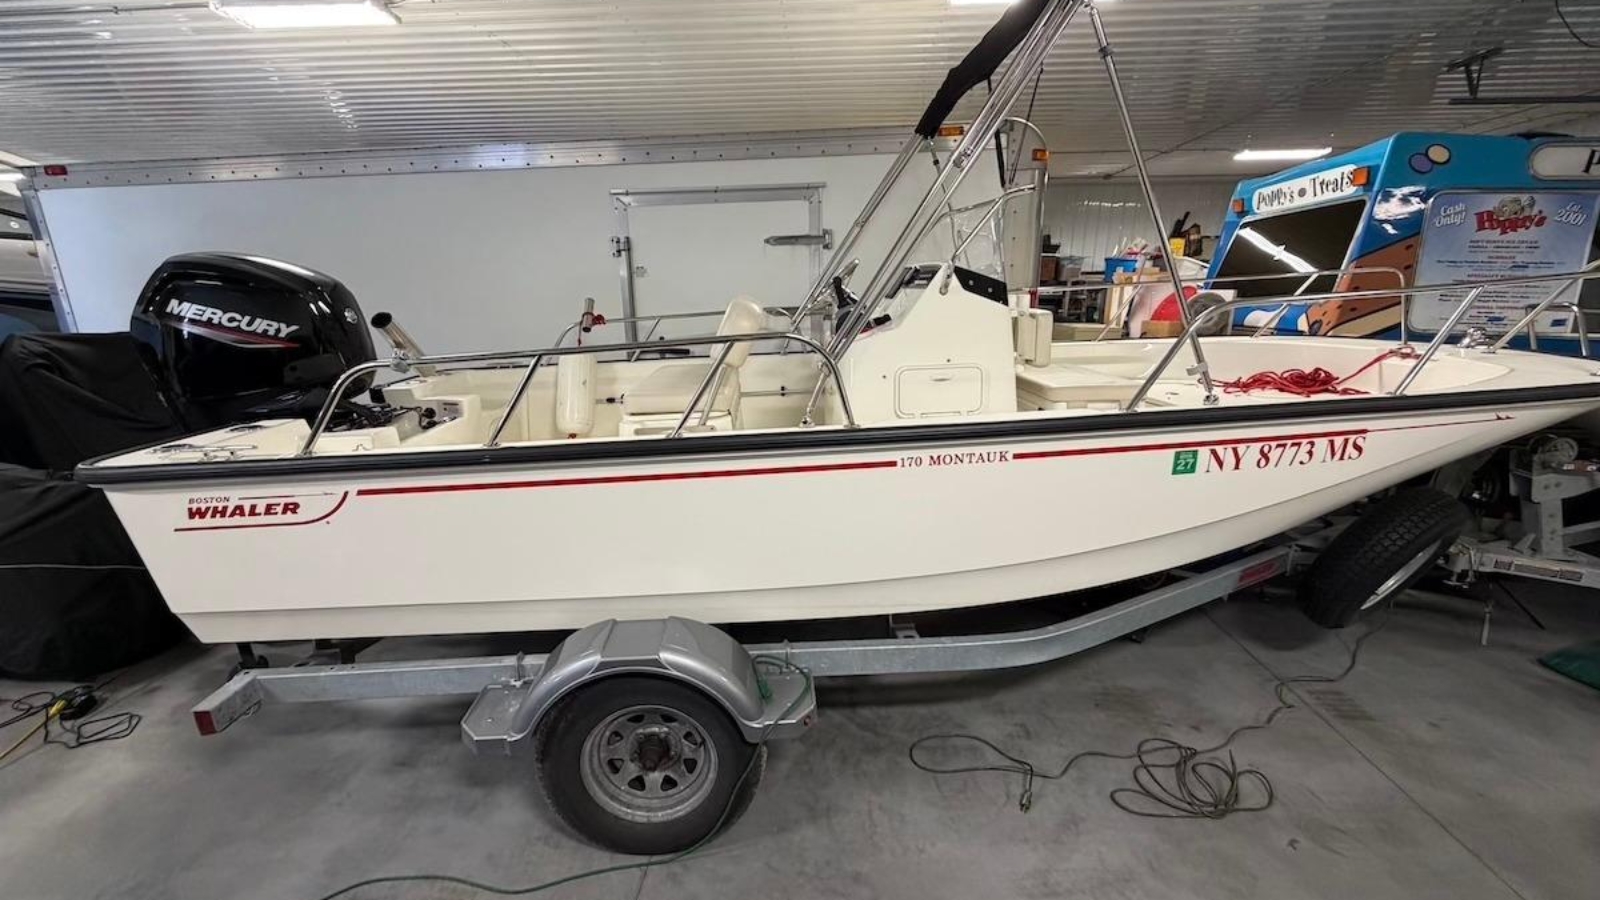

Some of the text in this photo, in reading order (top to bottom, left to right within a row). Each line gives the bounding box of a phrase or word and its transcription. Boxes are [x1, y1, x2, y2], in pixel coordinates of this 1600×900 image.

[1309, 170, 1354, 197] Treats
[1440, 202, 1466, 217] Cash
[1554, 209, 1587, 227] 2001
[1435, 211, 1466, 228] Only!
[165, 298, 300, 339] MERCURY
[900, 450, 1010, 468] 170 MONTAUK
[1205, 436, 1367, 473] NY 8773 MS
[1175, 458, 1195, 470] 27
[188, 496, 231, 505] BOSTON
[187, 502, 301, 520] WHALER
